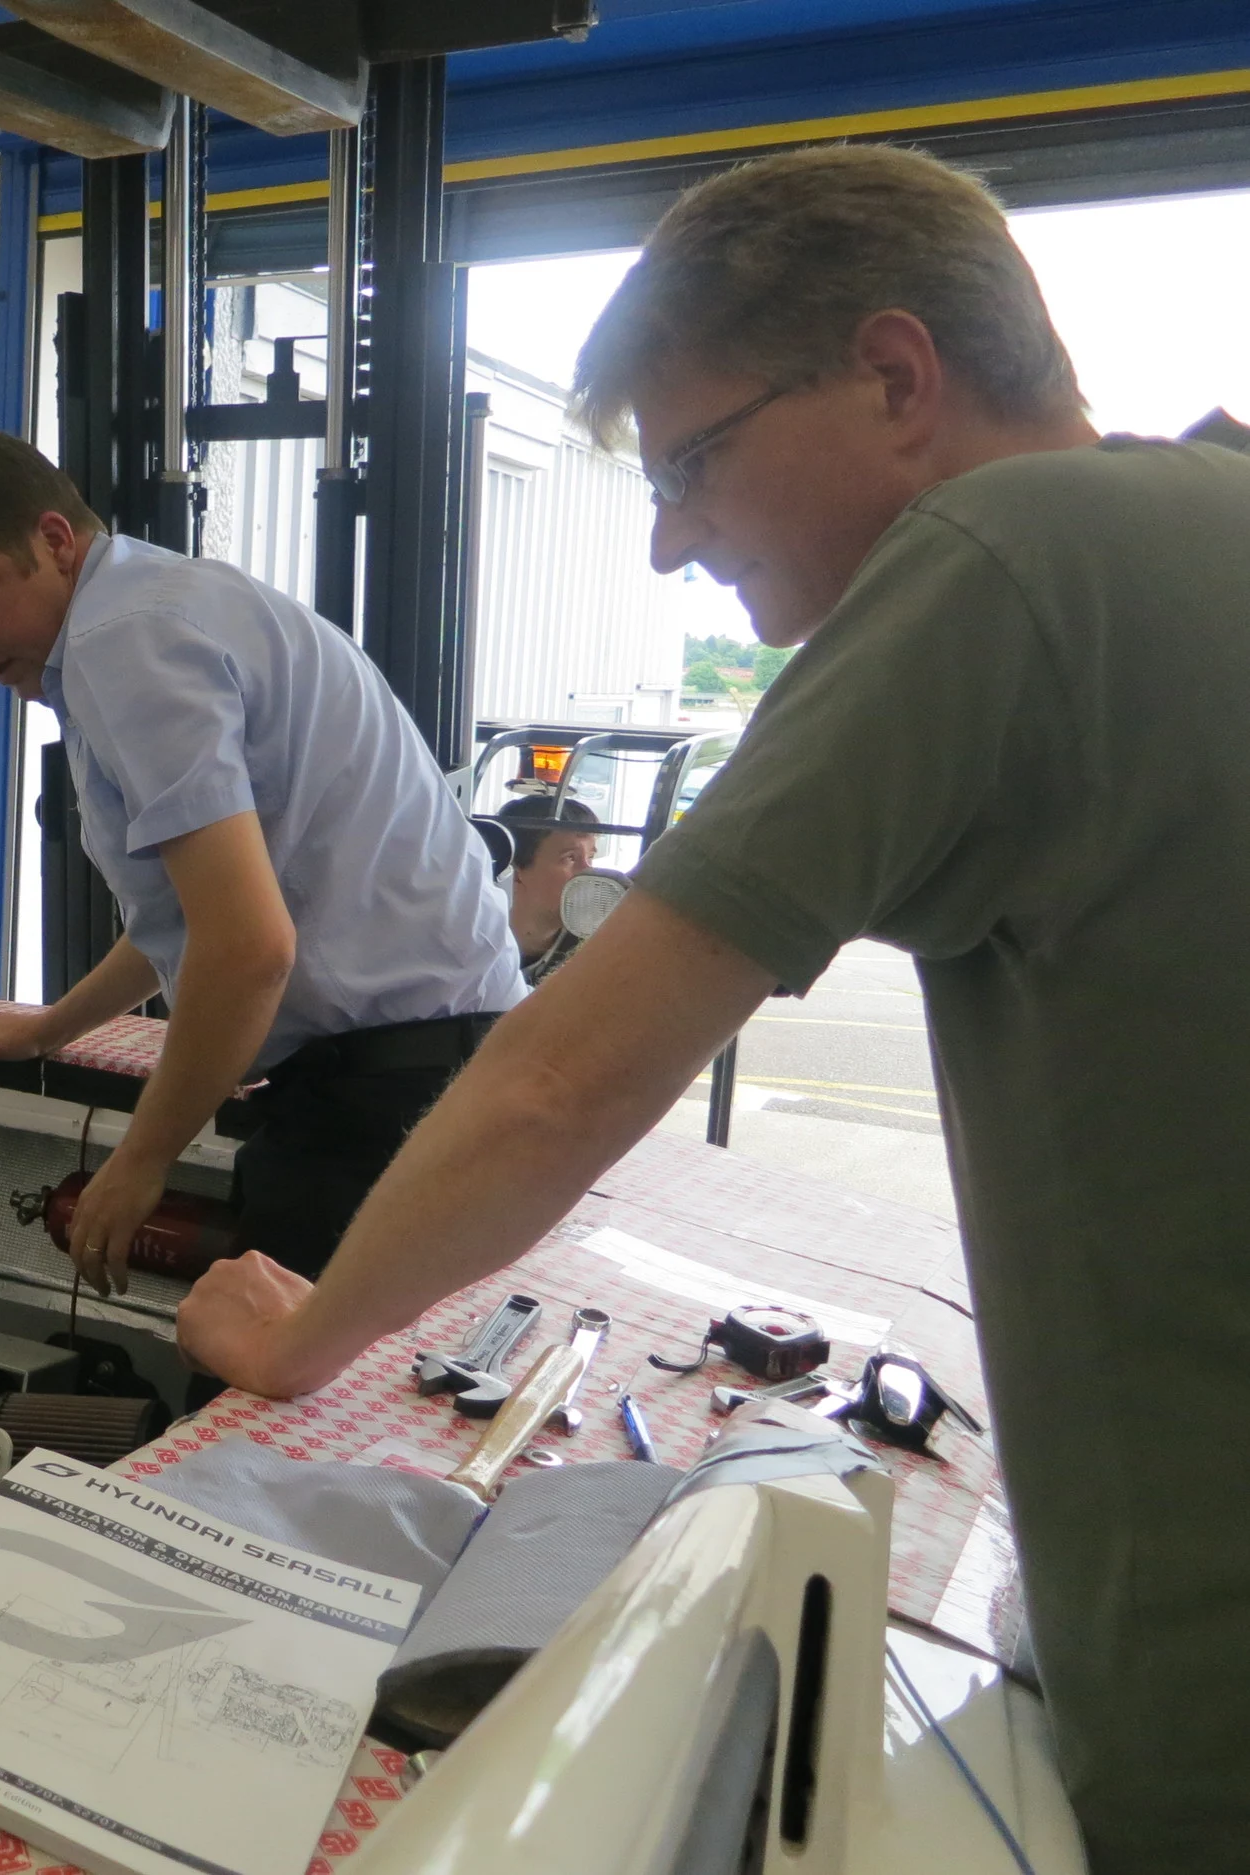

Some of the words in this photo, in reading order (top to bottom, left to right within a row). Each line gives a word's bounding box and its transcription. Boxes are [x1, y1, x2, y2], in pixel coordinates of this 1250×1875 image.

[315, 1397, 341, 1408] RS
[210, 1415, 243, 1429] RS
[229, 1409, 259, 1420] RS
[194, 1426, 220, 1441] RS
[172, 1438, 203, 1452] RS
[283, 1445, 313, 1462] RS
[154, 1448, 182, 1464] RS
[130, 1462, 163, 1475] RS
[85, 1478, 235, 1546] HYUNDAI
[242, 1543, 402, 1604] SEASALL
[9, 1483, 149, 1544] INSTALLATION
[153, 1541, 168, 1553] &
[174, 1551, 292, 1601] OPERATION
[298, 1598, 387, 1633] MANUAL
[149, 1549, 190, 1572] S270J
[192, 1567, 245, 1594] SERIES
[248, 1590, 315, 1619] ENGINES
[351, 1777, 401, 1800] RS
[3, 1789, 44, 1815] Edition
[336, 1800, 377, 1830] RS
[121, 1827, 164, 1851] models
